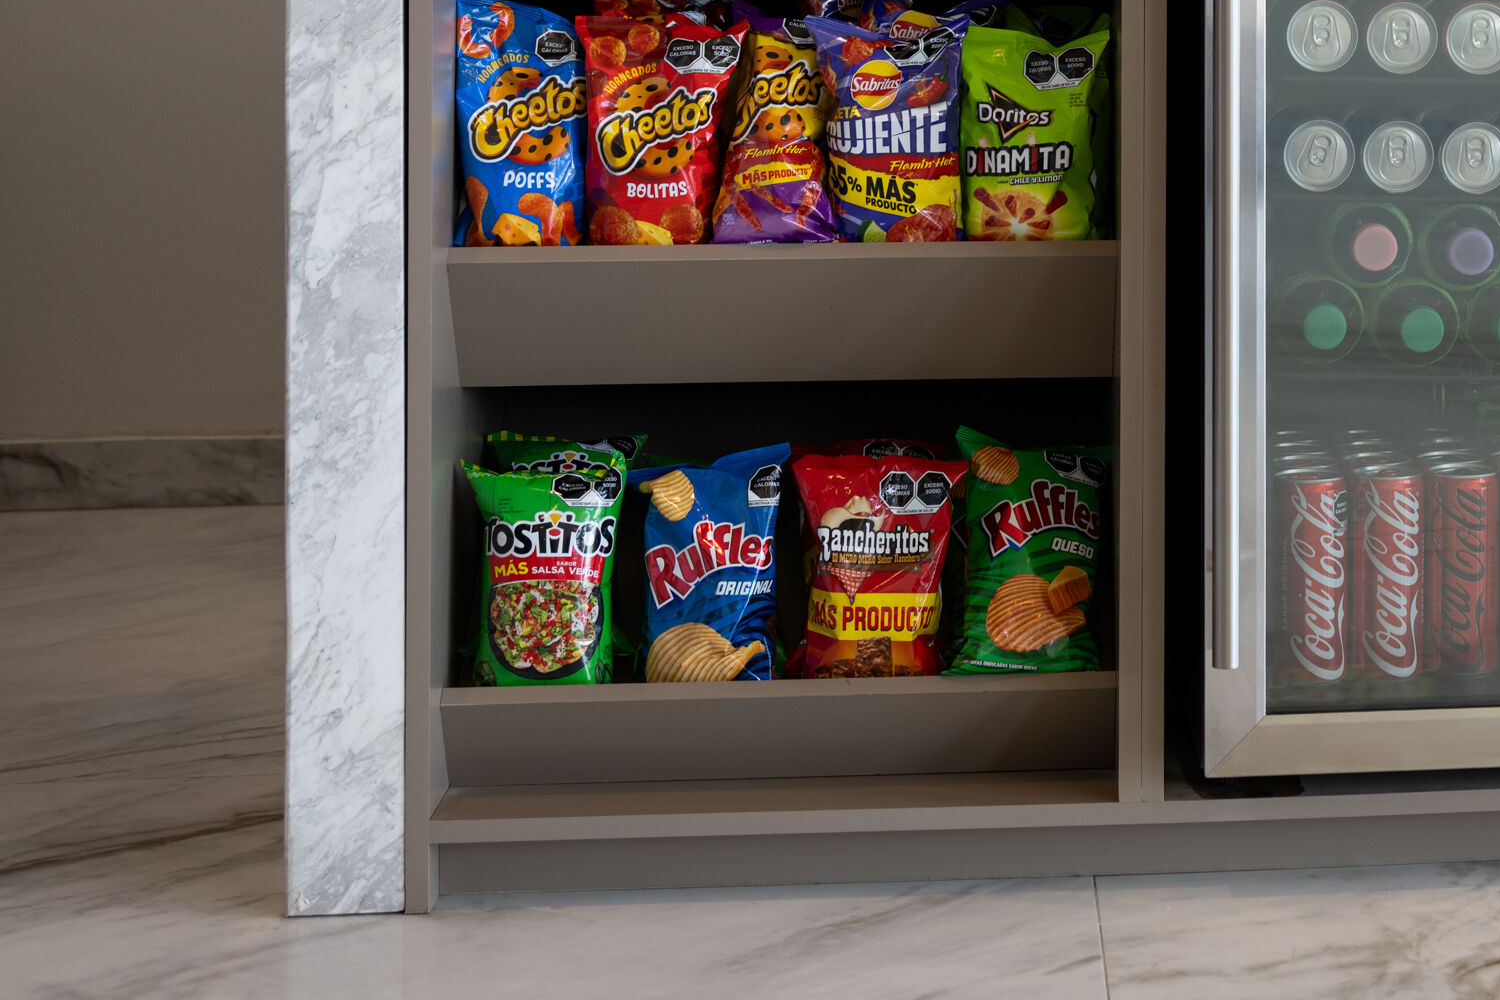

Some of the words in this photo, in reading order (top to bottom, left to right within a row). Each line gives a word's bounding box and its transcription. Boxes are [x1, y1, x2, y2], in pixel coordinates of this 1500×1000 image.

[477, 53, 530, 84] HORNEADOS
[603, 63, 657, 94] HORNEADOS
[850, 75, 900, 92] Sabritas
[471, 79, 587, 158] Cheetos
[978, 102, 1050, 126] Doritos
[599, 88, 714, 171] Cheetos
[785, 144, 808, 154] Hot
[967, 145, 1070, 174] DINAMITA
[934, 157, 956, 168] Hot
[503, 171, 555, 189] POFFS
[742, 169, 767, 185] MÁS
[768, 169, 808, 181] PRODUCTO
[1009, 176, 1031, 185] CHILE
[626, 181, 688, 199] BOLITAS
[866, 175, 916, 204] MÁS
[866, 197, 917, 214] PRODUCTO
[981, 479, 1100, 557] Ruffles
[817, 522, 929, 562] Rancheritos
[1051, 537, 1094, 560] QUESO
[494, 560, 529, 578] MÁS
[532, 566, 565, 574] SALSA
[569, 567, 599, 578] VERDE
[646, 521, 773, 607] Ruffles
[715, 580, 773, 596] ORIGINAL
[842, 605, 935, 632] PRODUCTO
